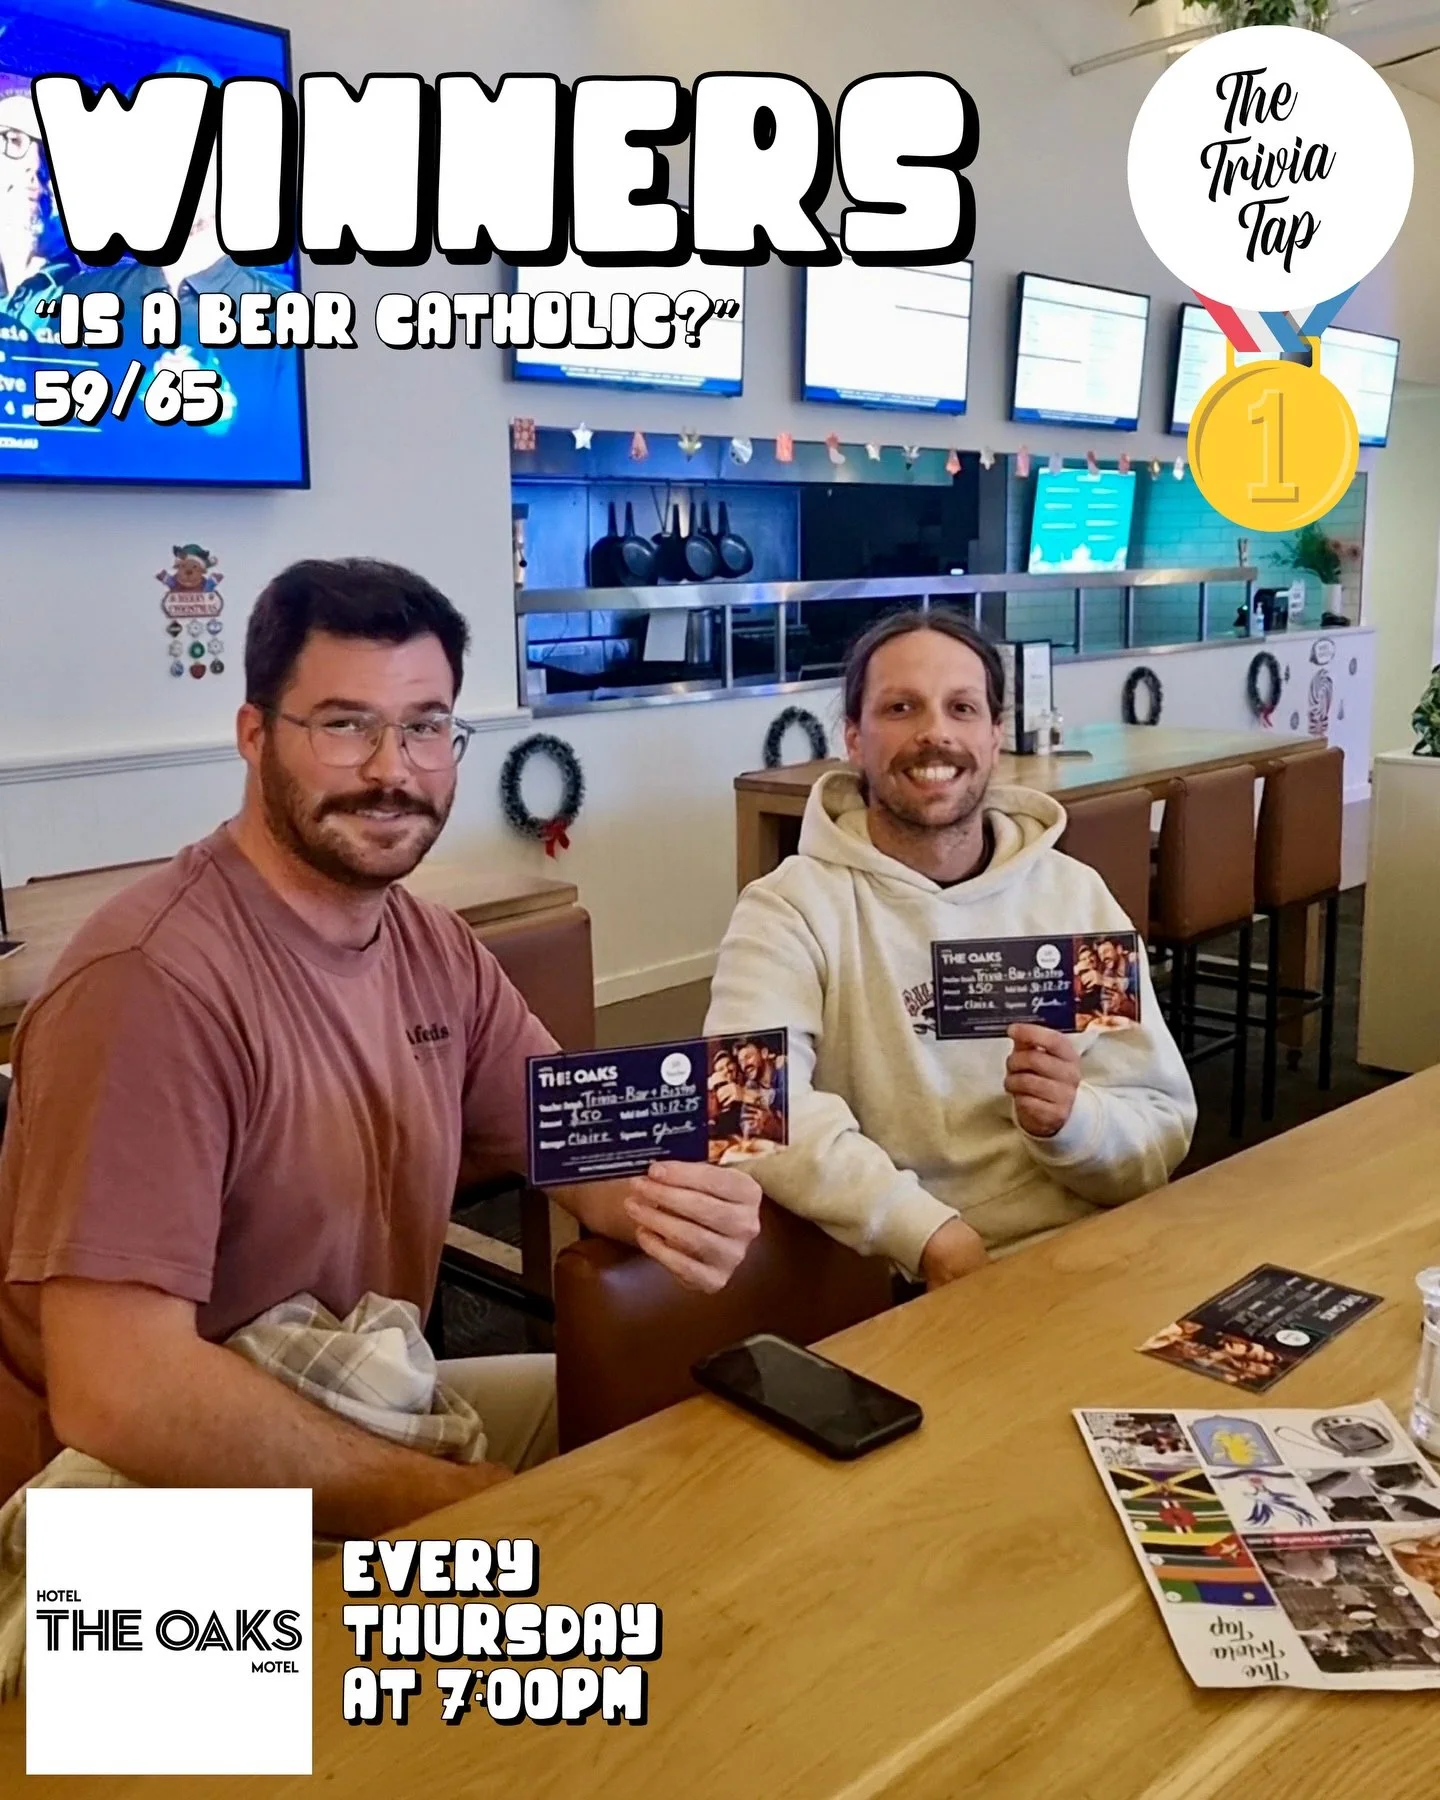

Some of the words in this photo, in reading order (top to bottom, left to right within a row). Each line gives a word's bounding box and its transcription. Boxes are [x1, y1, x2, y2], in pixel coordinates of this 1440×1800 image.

[941, 953, 967, 965] THE
[968, 952, 1002, 964] OAKS
[968, 982, 993, 995] $50
[538, 1072, 572, 1088] THE
[573, 1066, 619, 1084] OAKS
[571, 1109, 602, 1127] $50
[568, 1128, 612, 1146] Claire
[1210, 1615, 1254, 1643] Tap
[1213, 1638, 1285, 1661] Trivia
[1242, 1661, 1290, 1682] The
